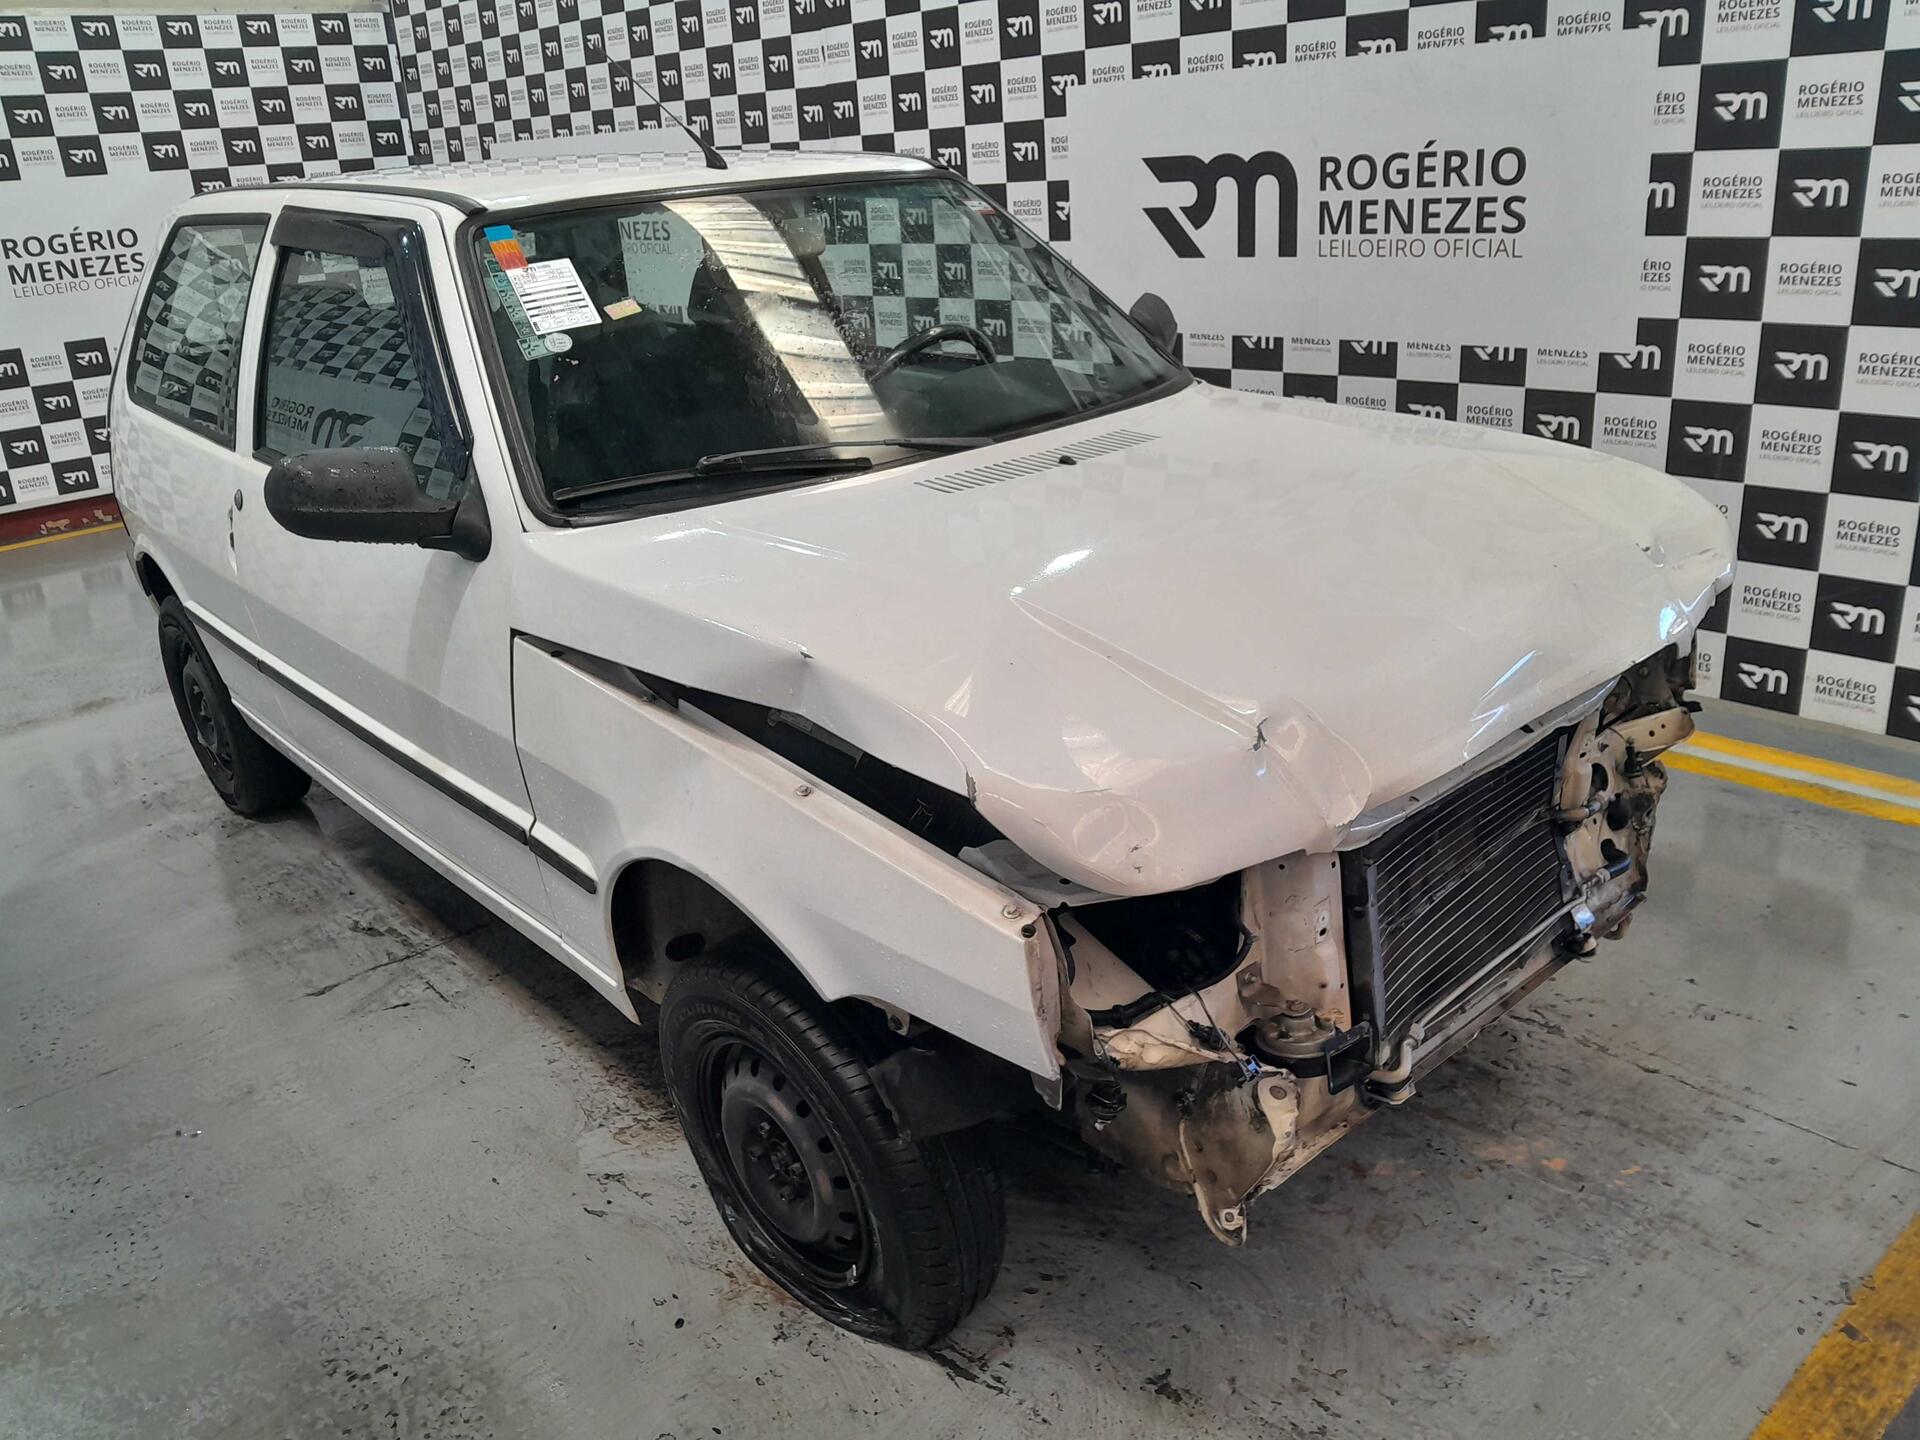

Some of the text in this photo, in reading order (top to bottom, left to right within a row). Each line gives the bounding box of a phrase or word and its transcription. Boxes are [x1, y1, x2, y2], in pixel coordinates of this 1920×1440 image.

[1046, 4, 1077, 17] ROGÉRIO
[1718, 0, 1781, 11] ROGÉRIO
[1046, 14, 1078, 26] MENEZES
[1557, 10, 1611, 26] ROGÉRIO
[1717, 7, 1780, 23] MENEZES
[964, 18, 993, 29] ROGÉRIO
[892, 30, 917, 41] ROGÉRIO
[965, 26, 993, 38] MENEZES
[1417, 26, 1465, 40] ROGÉRIO
[826, 41, 849, 52] ROGÉRIO
[892, 38, 918, 49] MENEZES
[1295, 40, 1336, 54] ROGÉRIO
[796, 47, 820, 57] ROGÉRIO
[827, 50, 850, 61] MENEZES
[797, 55, 820, 64] MENEZES
[1007, 75, 1037, 86] ROGÉRIO
[931, 84, 958, 95] ROGÉRIO
[1007, 84, 1037, 95] MENEZES
[1798, 80, 1865, 96] ROGÉRIO
[220, 98, 248, 106] ROGÉRIO
[862, 93, 887, 103] ROGÉRIO
[931, 93, 959, 103] MENEZES
[1797, 94, 1863, 108] MENEZES
[771, 105, 792, 113] ROGÉRIO
[863, 101, 888, 111] MENEZES
[771, 112, 793, 120] MENEZES
[266, 135, 293, 143] ROGÉRIO
[108, 144, 138, 152] ROGÉRIO
[971, 141, 999, 150] ROGÉRIO
[972, 149, 1000, 159] MENEZES
[1319, 140, 1527, 191] ROGÉRIO
[1703, 174, 1763, 188] ROGÉRIO
[1702, 188, 1762, 199] MENEZES
[1013, 199, 1042, 208] ROGÉRIO
[1013, 208, 1042, 218] MENEZES
[1318, 195, 1527, 235] MENEZES
[620, 220, 671, 241] NEZES
[0, 226, 138, 259] ROGÉRIO
[1318, 238, 1523, 258] LEILOEIRO OFICIAL
[7, 252, 145, 285] MENEZES
[1779, 261, 1842, 275] ROGÉRIO
[13, 275, 141, 299] LEILOEIRO OFICIA
[1778, 275, 1841, 287] MENEZES
[1688, 342, 1746, 356] ROGÉRIO
[30, 354, 61, 363] ROGÉRIO
[31, 360, 62, 368] MENEZES
[1687, 354, 1745, 368] MENEZES
[1345, 395, 1387, 407] ROGÉRIO
[1466, 404, 1513, 418] ROGÉRIO
[1465, 414, 1513, 427] MENEZES
[1604, 416, 1657, 430] ROGÉRIO
[50, 430, 80, 441] ROGÉRIO
[1603, 426, 1657, 440] MENEZES
[1761, 429, 1822, 444] ROGÉRIO
[51, 435, 81, 445] MENEZES
[1760, 440, 1821, 456] MENEZES
[17, 474, 48, 485] ROGÉRIO
[19, 480, 50, 490] MENEZES
[1838, 519, 1901, 536] ROGÉRIO
[1836, 530, 1900, 548] MENEZES
[1743, 585, 1802, 603] ROGÉRIO
[1742, 595, 1801, 613] MENEZES
[1816, 674, 1877, 694] ROGÉRIO
[1815, 685, 1876, 705] MENEZES
